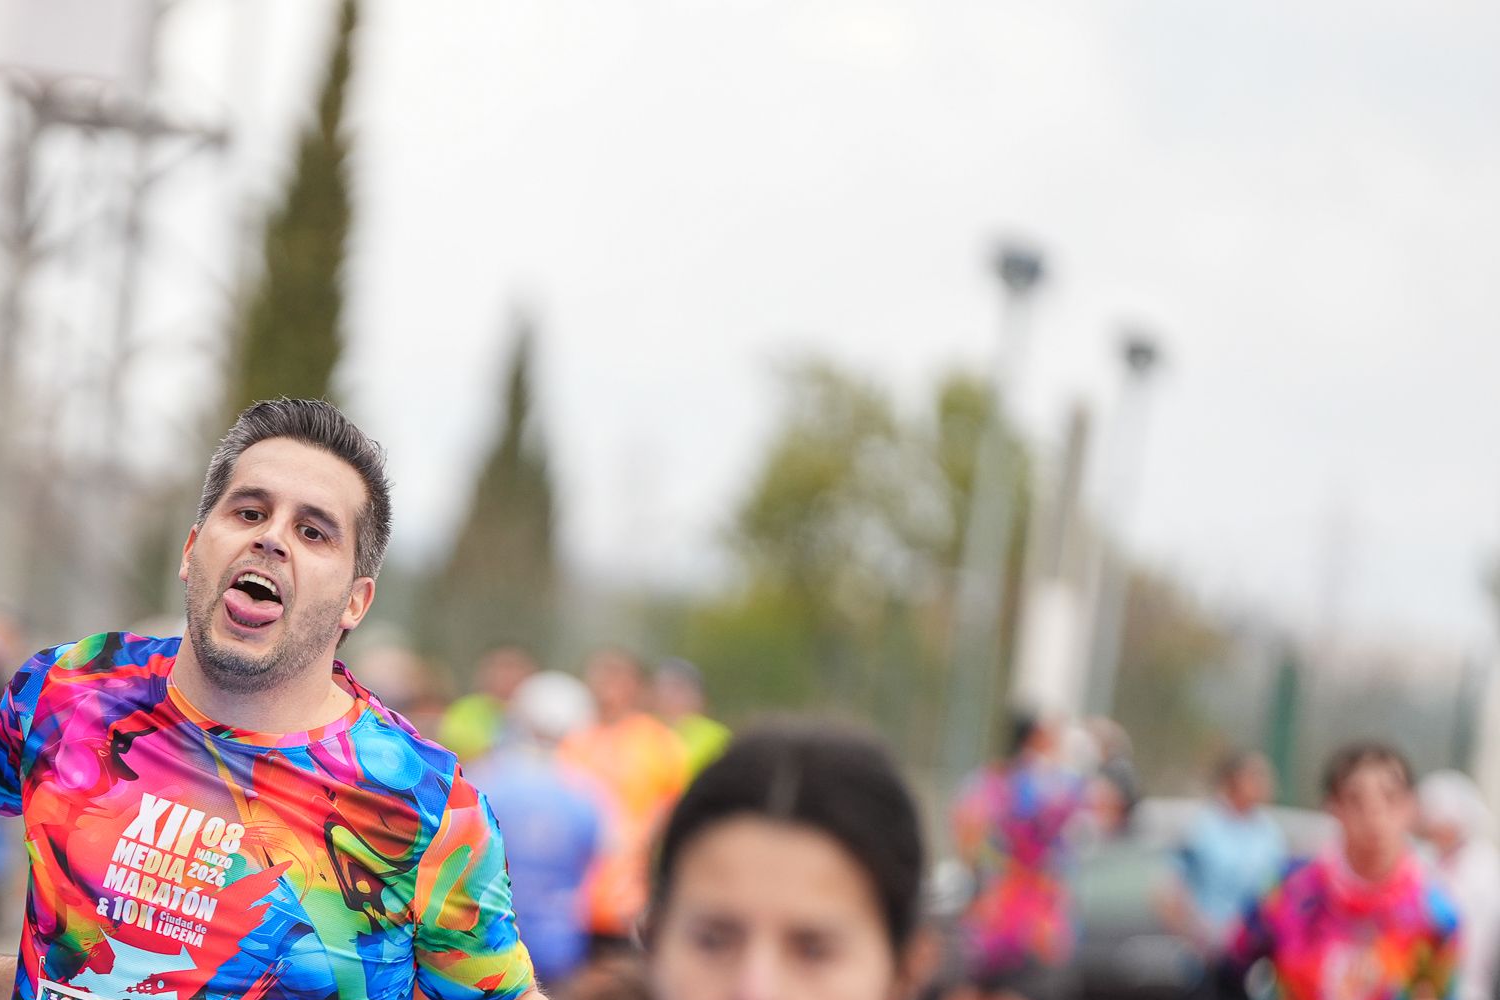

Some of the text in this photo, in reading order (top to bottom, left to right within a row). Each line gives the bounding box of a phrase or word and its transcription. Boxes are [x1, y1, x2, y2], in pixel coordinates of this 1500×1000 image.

[123, 792, 206, 857] XII
[201, 817, 245, 854] 08
[112, 838, 186, 884] MEDIA
[187, 861, 227, 887] 2026
[194, 848, 233, 869] MARZO
[102, 864, 218, 922] MARATÓN
[96, 896, 157, 931] & 10K
[159, 911, 207, 934] Ciudad de
[156, 922, 204, 948] LUCENA
